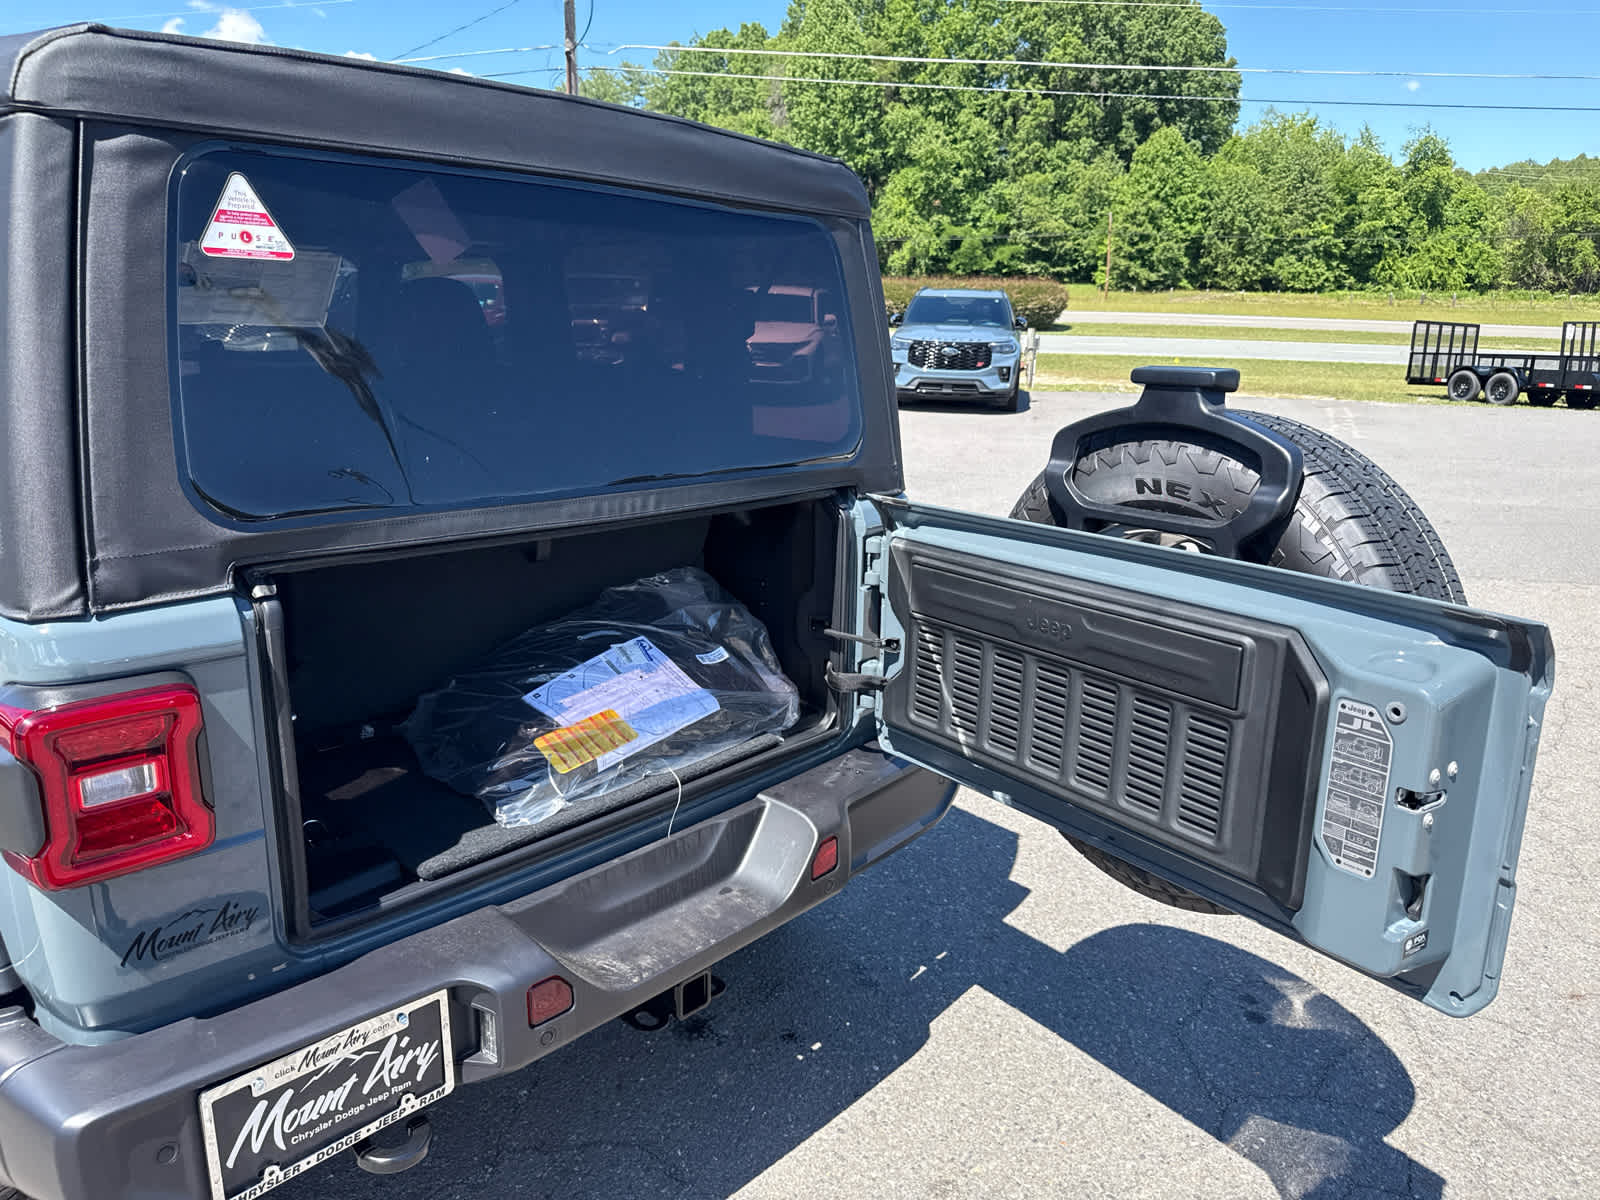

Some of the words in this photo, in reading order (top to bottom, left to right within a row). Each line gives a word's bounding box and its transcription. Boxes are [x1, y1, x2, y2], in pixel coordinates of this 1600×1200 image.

[218, 231, 275, 243] PULSE
[1026, 609, 1072, 642] Jeep
[1347, 704, 1367, 715] Jeep
[1347, 834, 1374, 849] USA
[120, 922, 204, 968] Mount
[208, 900, 259, 934] Airy
[274, 1065, 296, 1080] click
[297, 1042, 342, 1073] Mount
[225, 1073, 359, 1169] Mount
[362, 1033, 440, 1096] Airy
[290, 1119, 333, 1146] Chrysler
[335, 1104, 366, 1123] Dodge
[367, 1092, 390, 1109] Jeep
[391, 1080, 412, 1094] Ram
[229, 1164, 304, 1200] HRYSLER
[316, 1132, 363, 1163] DODGE
[375, 1108, 407, 1133] JEEP
[419, 1088, 447, 1108] RAM
